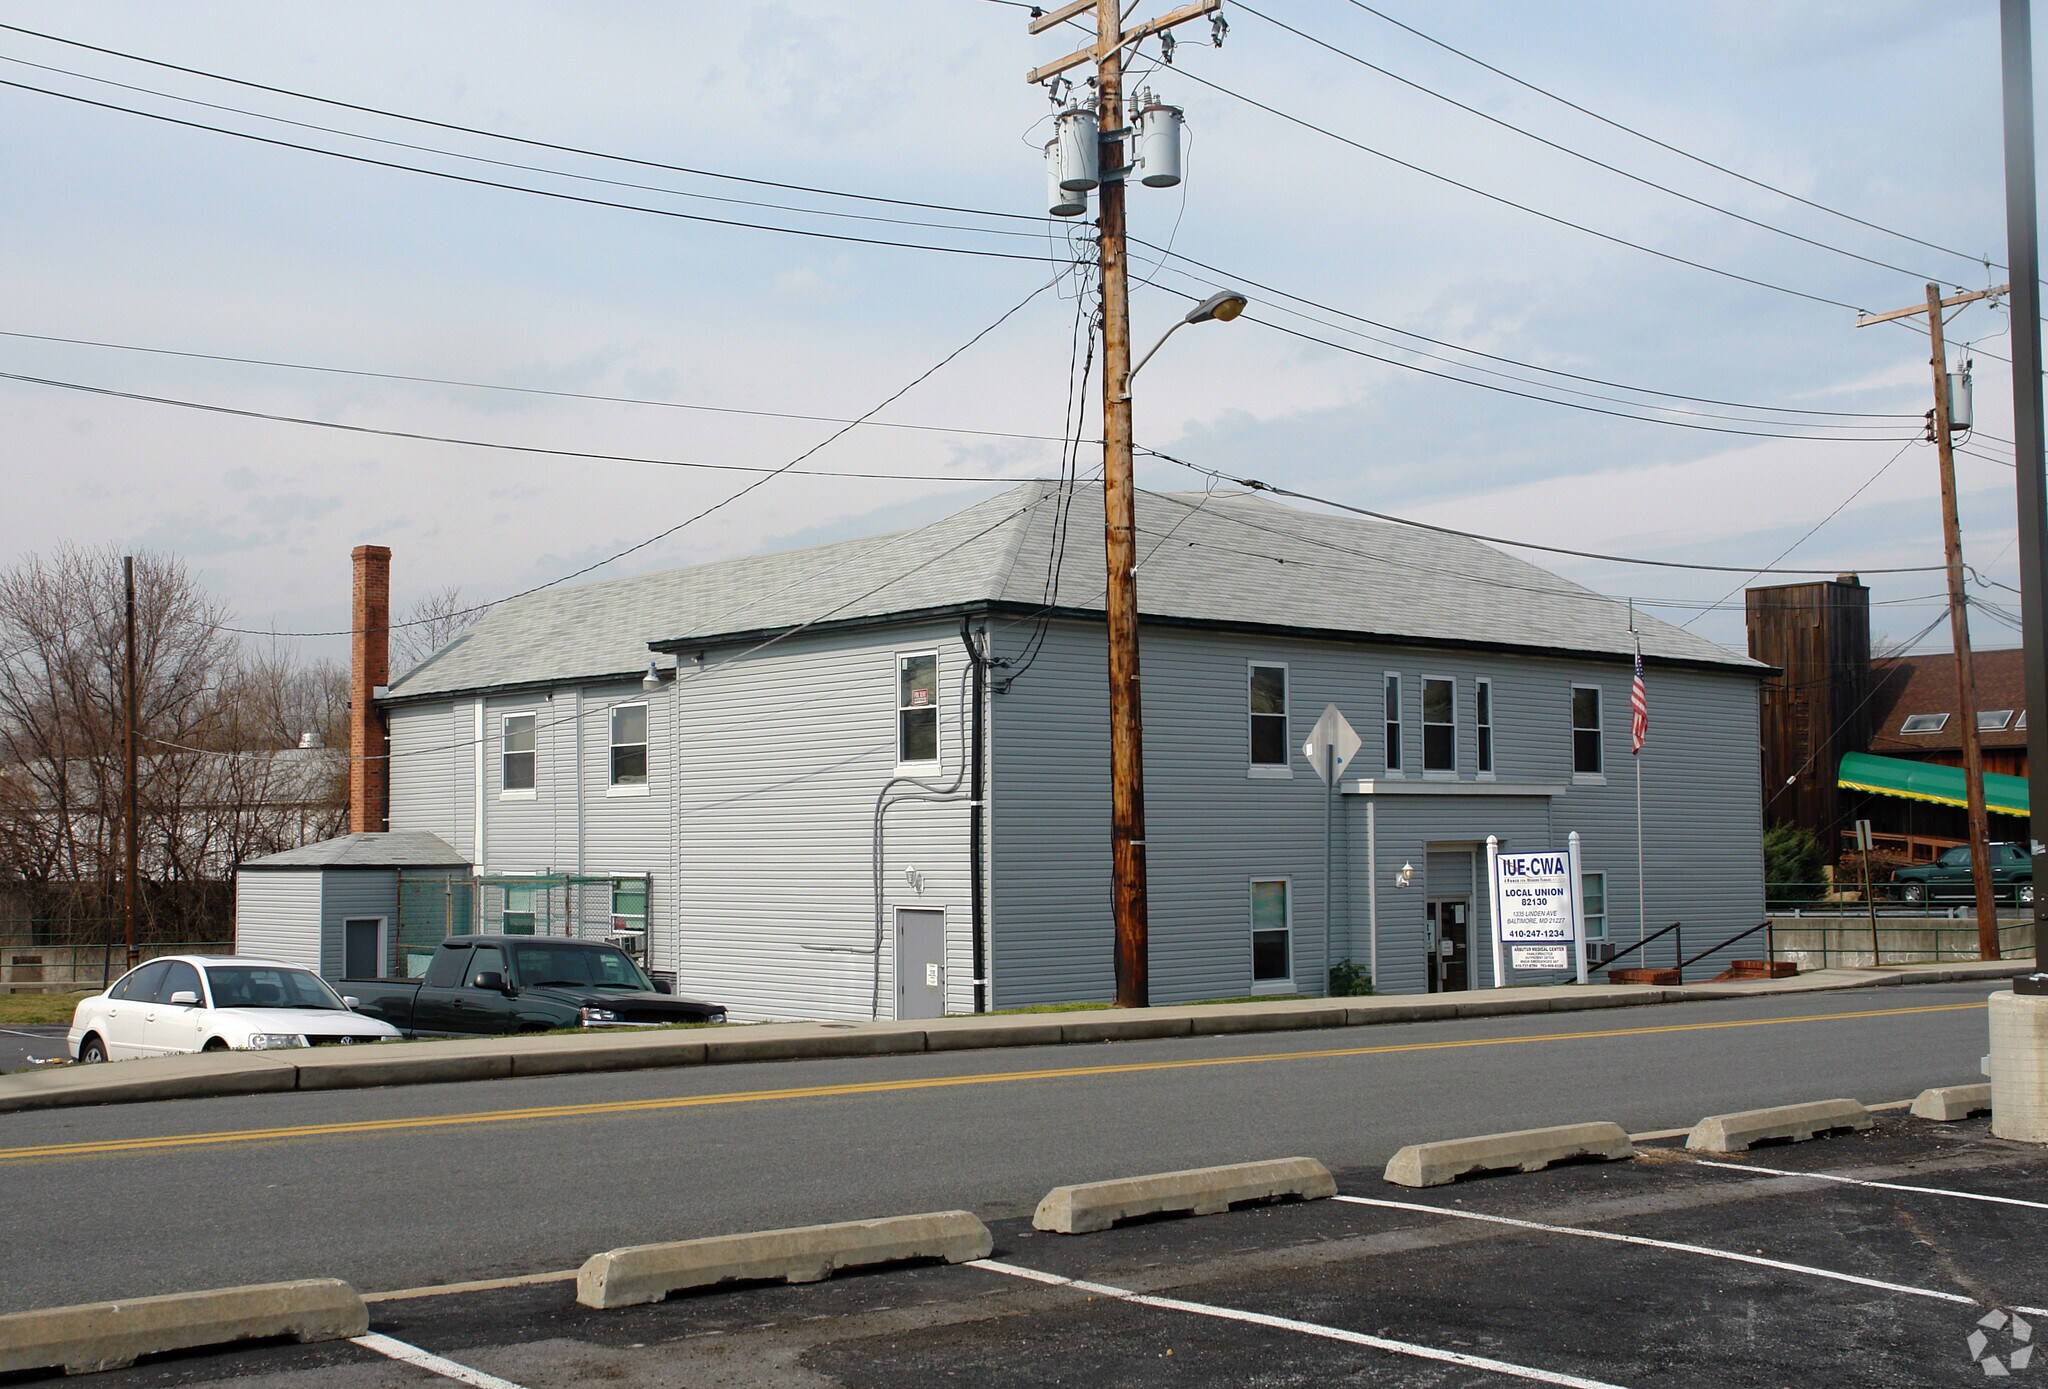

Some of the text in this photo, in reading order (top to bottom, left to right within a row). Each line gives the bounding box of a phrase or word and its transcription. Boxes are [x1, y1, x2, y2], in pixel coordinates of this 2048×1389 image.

[1503, 857, 1565, 876] IUE-CWA
[1505, 888, 1564, 897] LOCAL UNION
[1521, 898, 1548, 906] 82130
[1509, 930, 1565, 938] 410-247-1234
